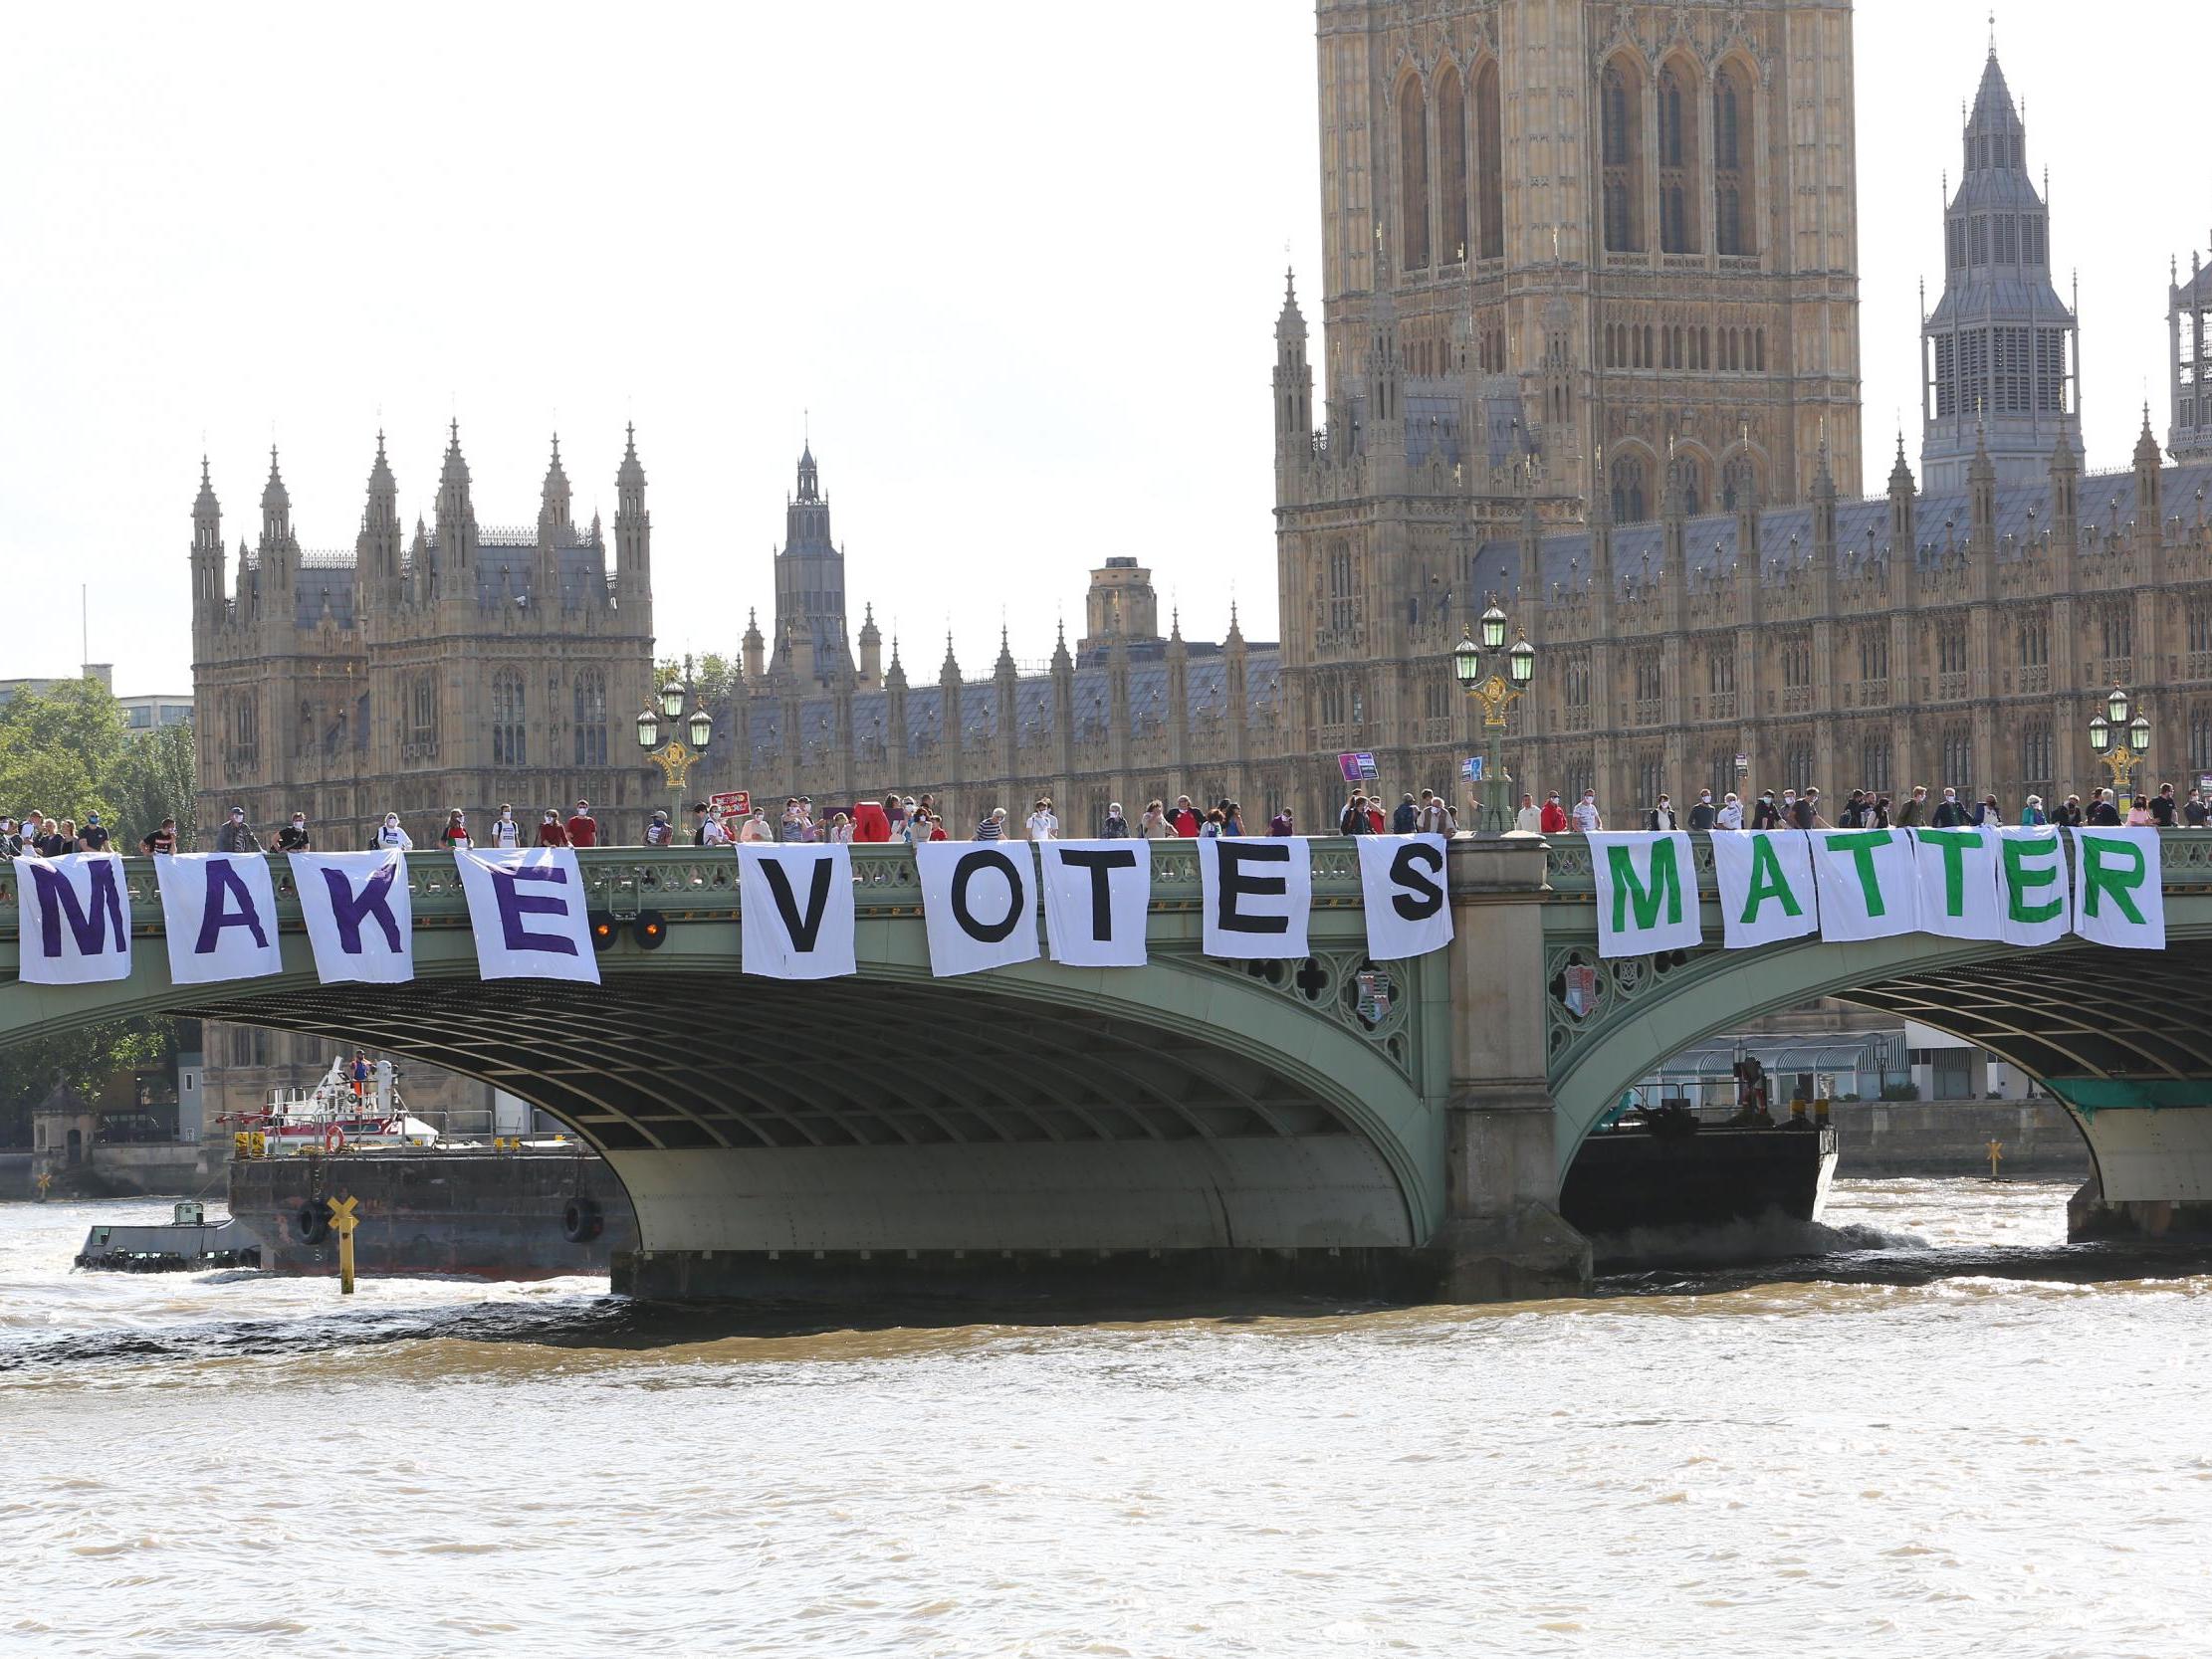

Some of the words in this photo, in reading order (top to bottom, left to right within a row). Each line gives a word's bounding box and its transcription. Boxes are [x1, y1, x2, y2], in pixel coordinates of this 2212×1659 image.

[30, 858, 579, 957] MAKE
[758, 840, 1443, 952] VOTES
[1608, 829, 2145, 932] MATTER
